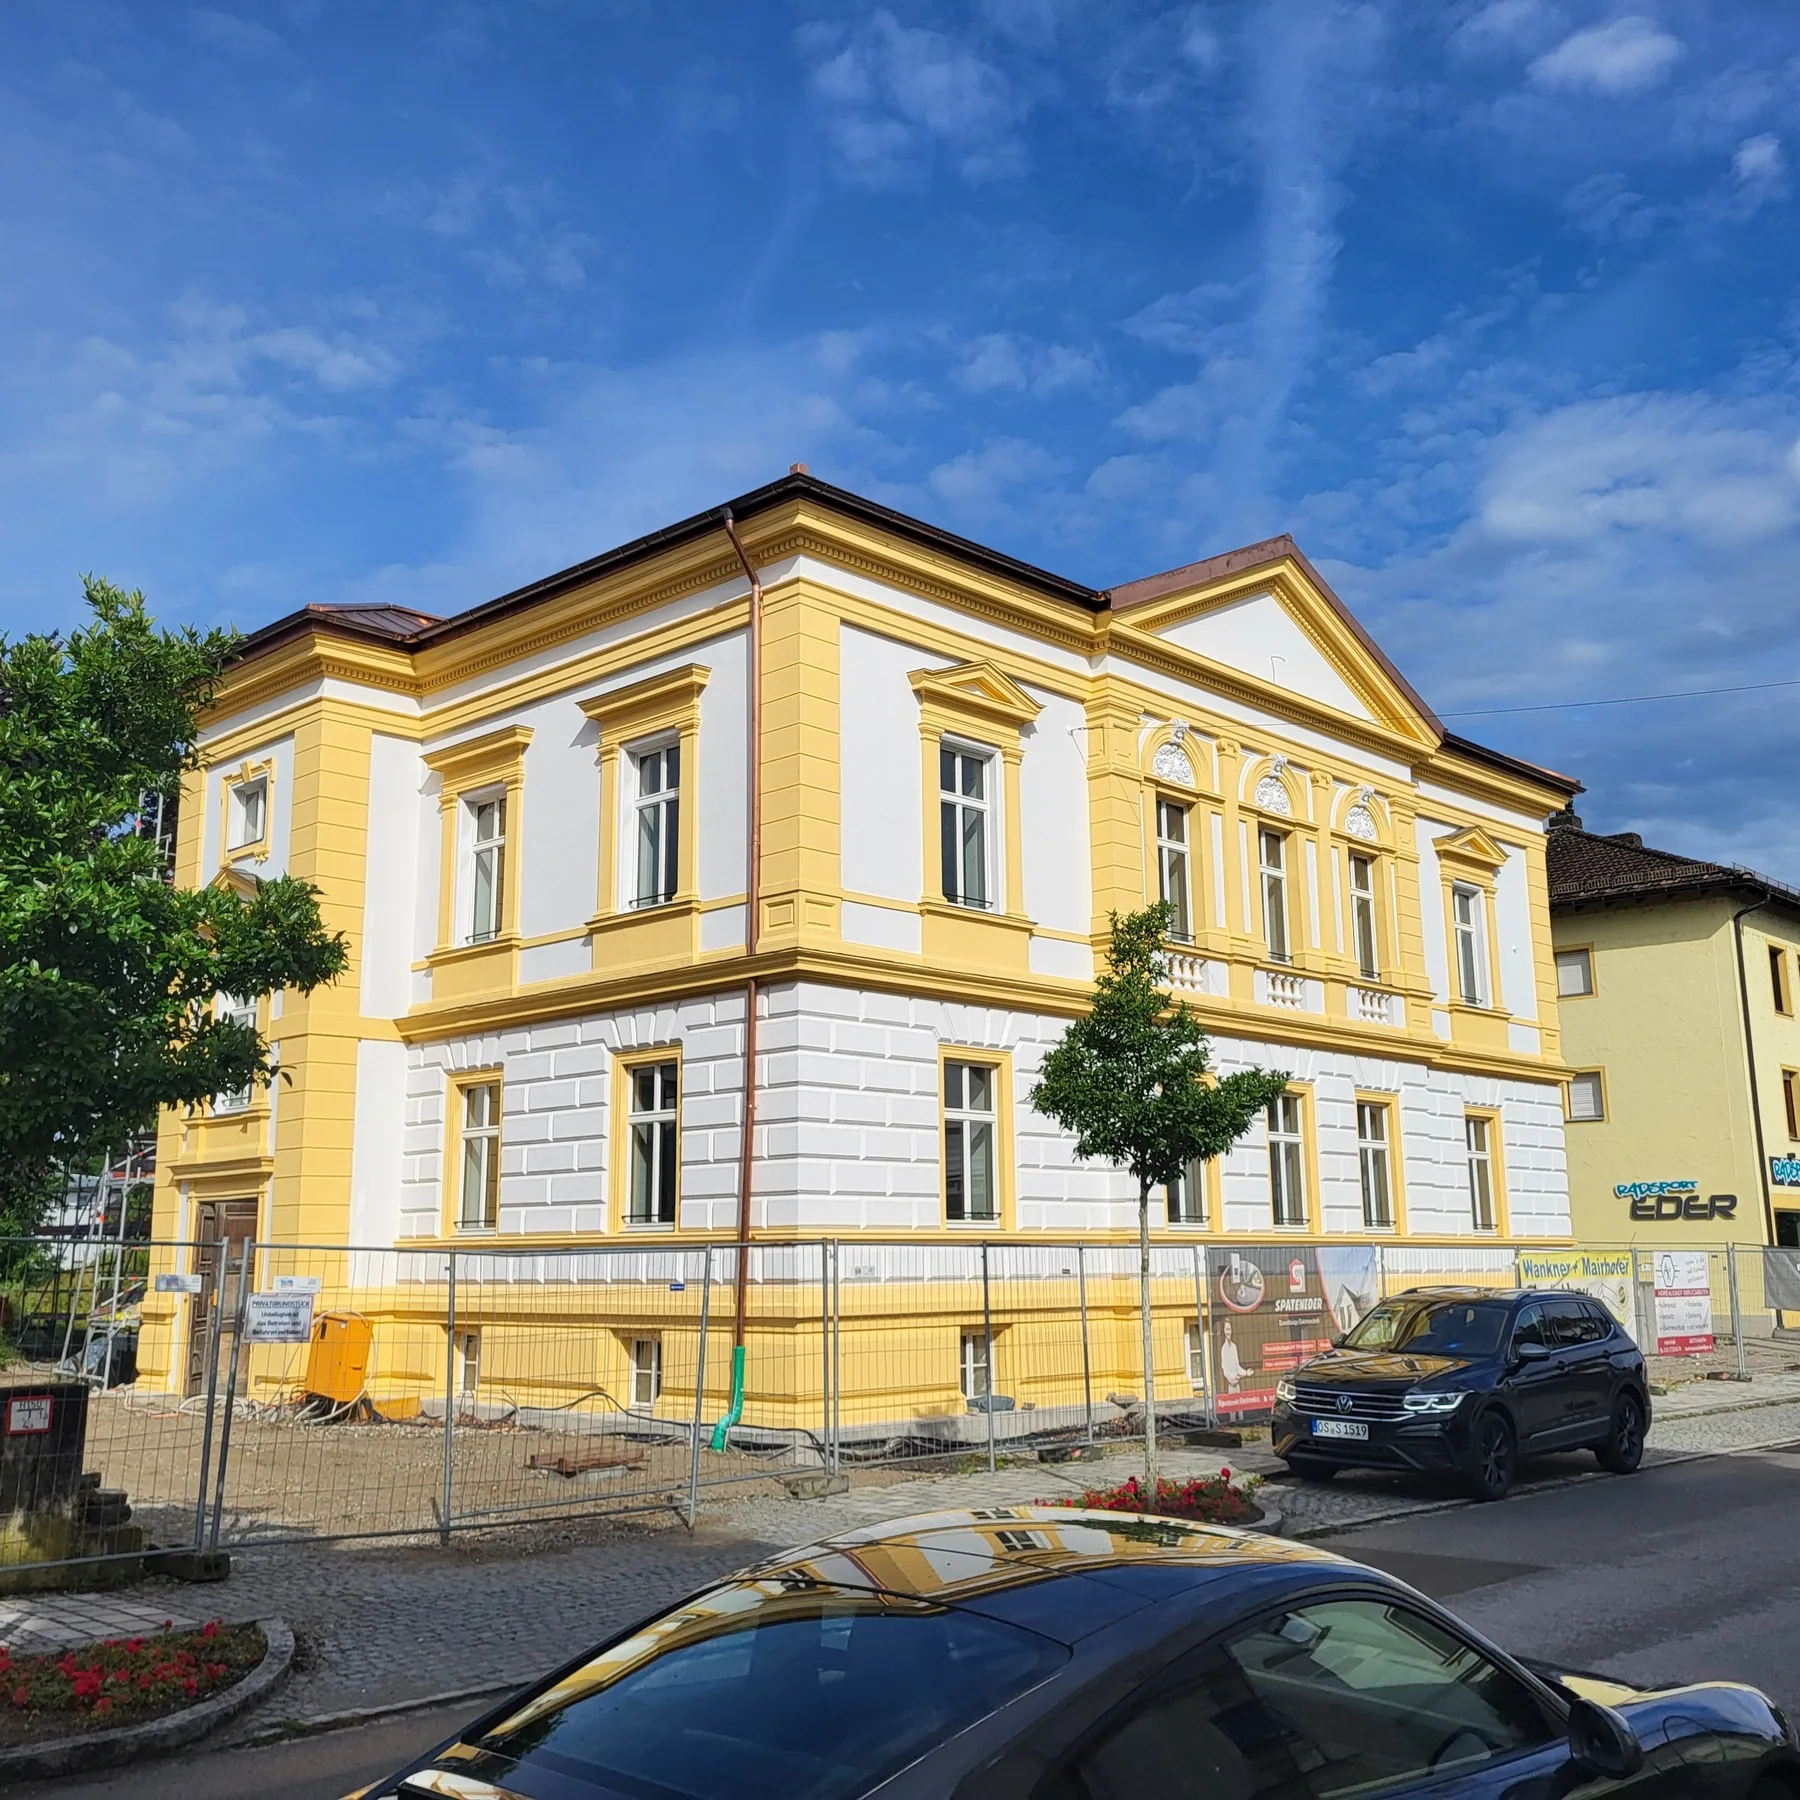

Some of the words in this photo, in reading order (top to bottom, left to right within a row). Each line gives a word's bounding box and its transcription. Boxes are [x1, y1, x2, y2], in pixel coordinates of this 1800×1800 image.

[1614, 1180, 1698, 1200] RADSPORT
[1631, 1194, 1737, 1220] EDER
[1522, 1258, 1570, 1278] Wankner
[1581, 1256, 1629, 1276] Mairhofer
[1275, 1298, 1323, 1312] SPATENEDER
[1318, 1421, 1330, 1433] OS
[1343, 1424, 1367, 1437] 1519
